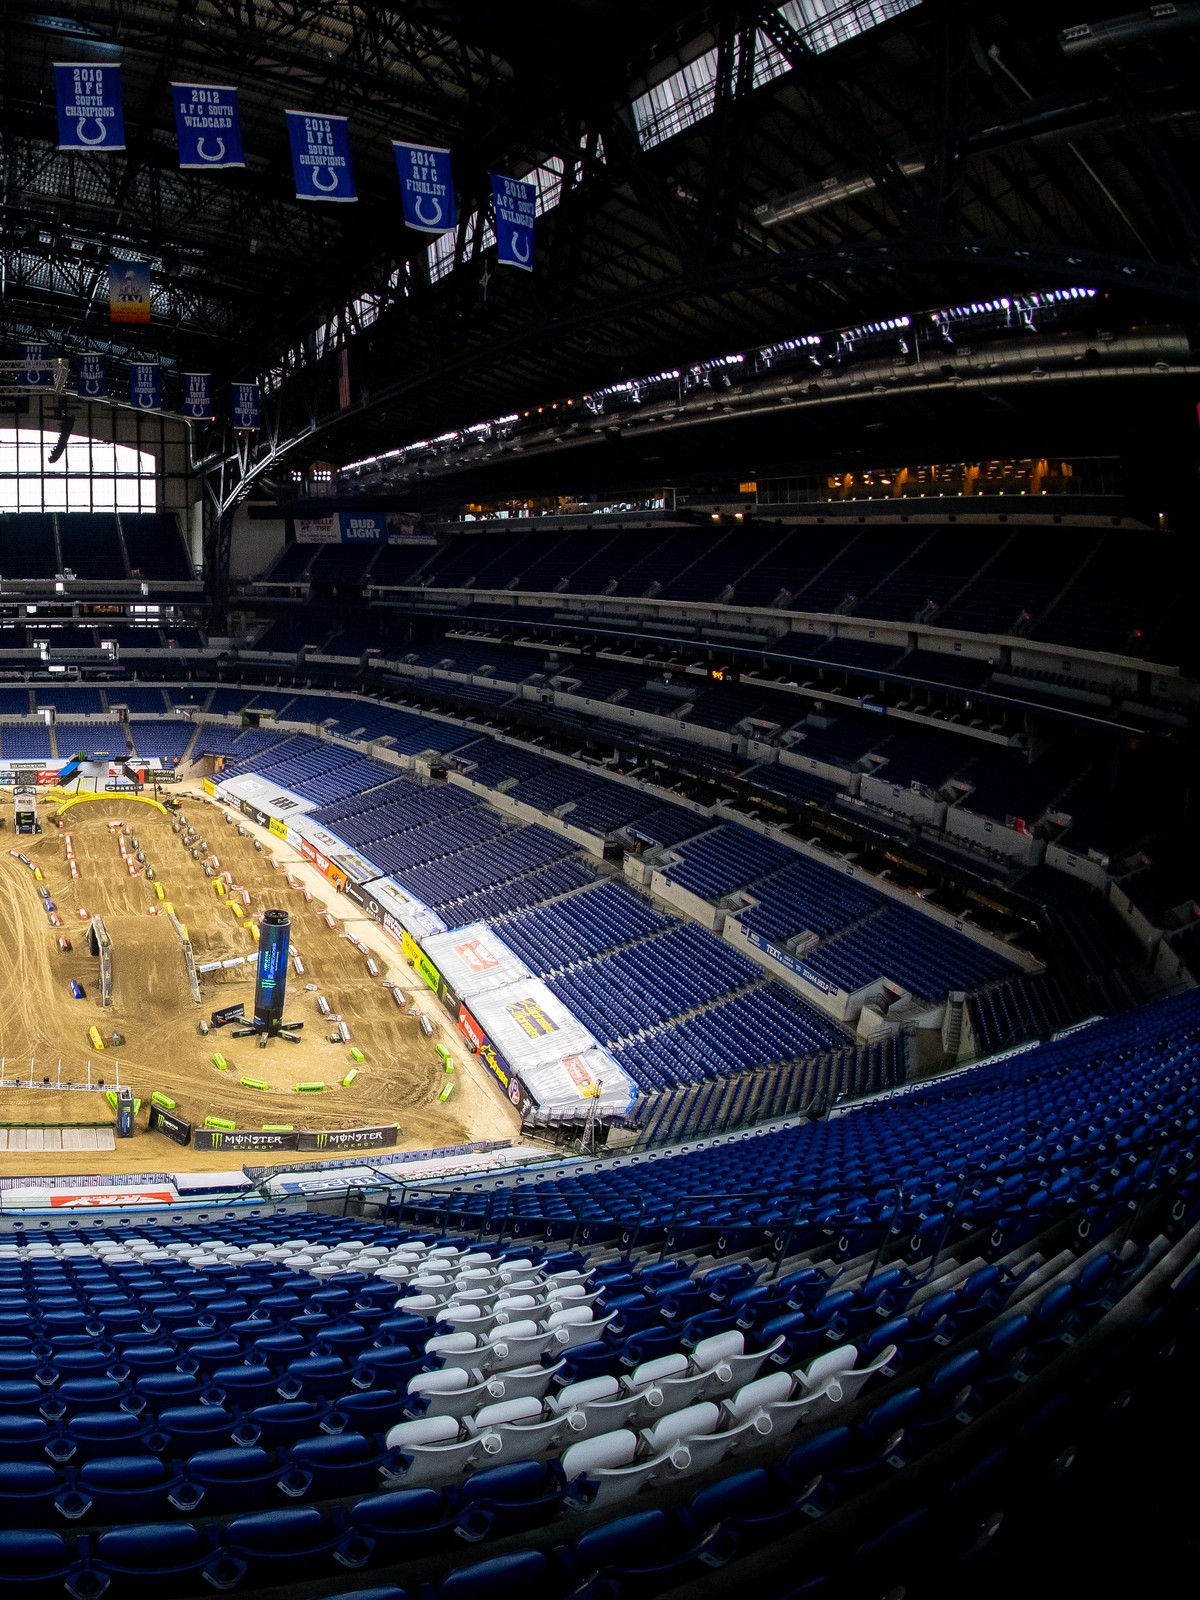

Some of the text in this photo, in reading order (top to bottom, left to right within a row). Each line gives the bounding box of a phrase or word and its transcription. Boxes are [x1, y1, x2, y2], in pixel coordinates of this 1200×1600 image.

[73, 68, 103, 82] 2010
[75, 95, 104, 107] SOUTH
[191, 90, 220, 104] 2012
[65, 106, 115, 118] CHAMPIONS
[208, 104, 234, 117] SOUTH
[184, 116, 232, 129] WILDCARD
[304, 117, 331, 132] 2013
[307, 144, 335, 157] SOUTH
[299, 154, 347, 167] CHAMPIONS
[410, 150, 436, 167] 2014
[406, 178, 446, 197] FINALIST
[349, 519, 375, 529] BUD
[346, 528, 381, 538] LIGHT
[270, 821, 287, 835] SUZUKI
[420, 958, 438, 985] Kawasaki
[463, 1019, 480, 1049] HONDA
[206, 1120, 232, 1129] Kawasaki
[225, 1135, 283, 1144] MONSTER
[329, 1131, 384, 1143] MONSTER
[337, 1141, 375, 1149] ENERGY
